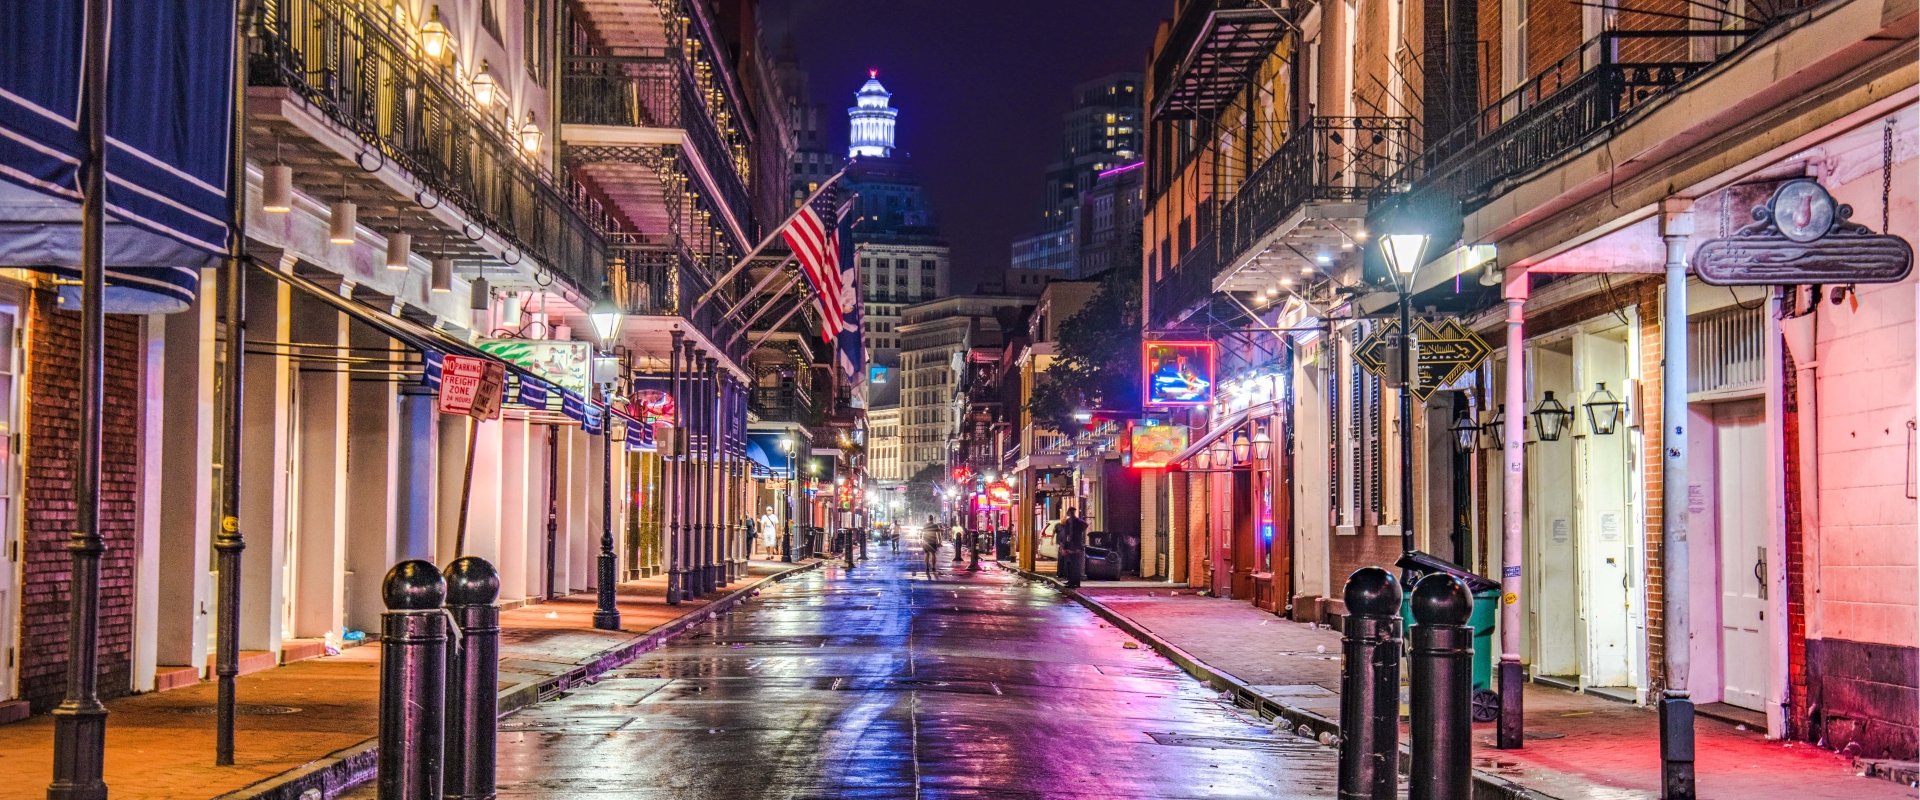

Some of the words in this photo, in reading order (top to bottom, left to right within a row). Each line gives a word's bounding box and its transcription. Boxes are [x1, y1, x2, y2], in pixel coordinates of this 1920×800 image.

[443, 359, 455, 372] NO
[455, 363, 481, 373] PARKING
[445, 376, 477, 387] FREIGHT
[449, 386, 470, 396] ZONE
[482, 383, 494, 394] ANY
